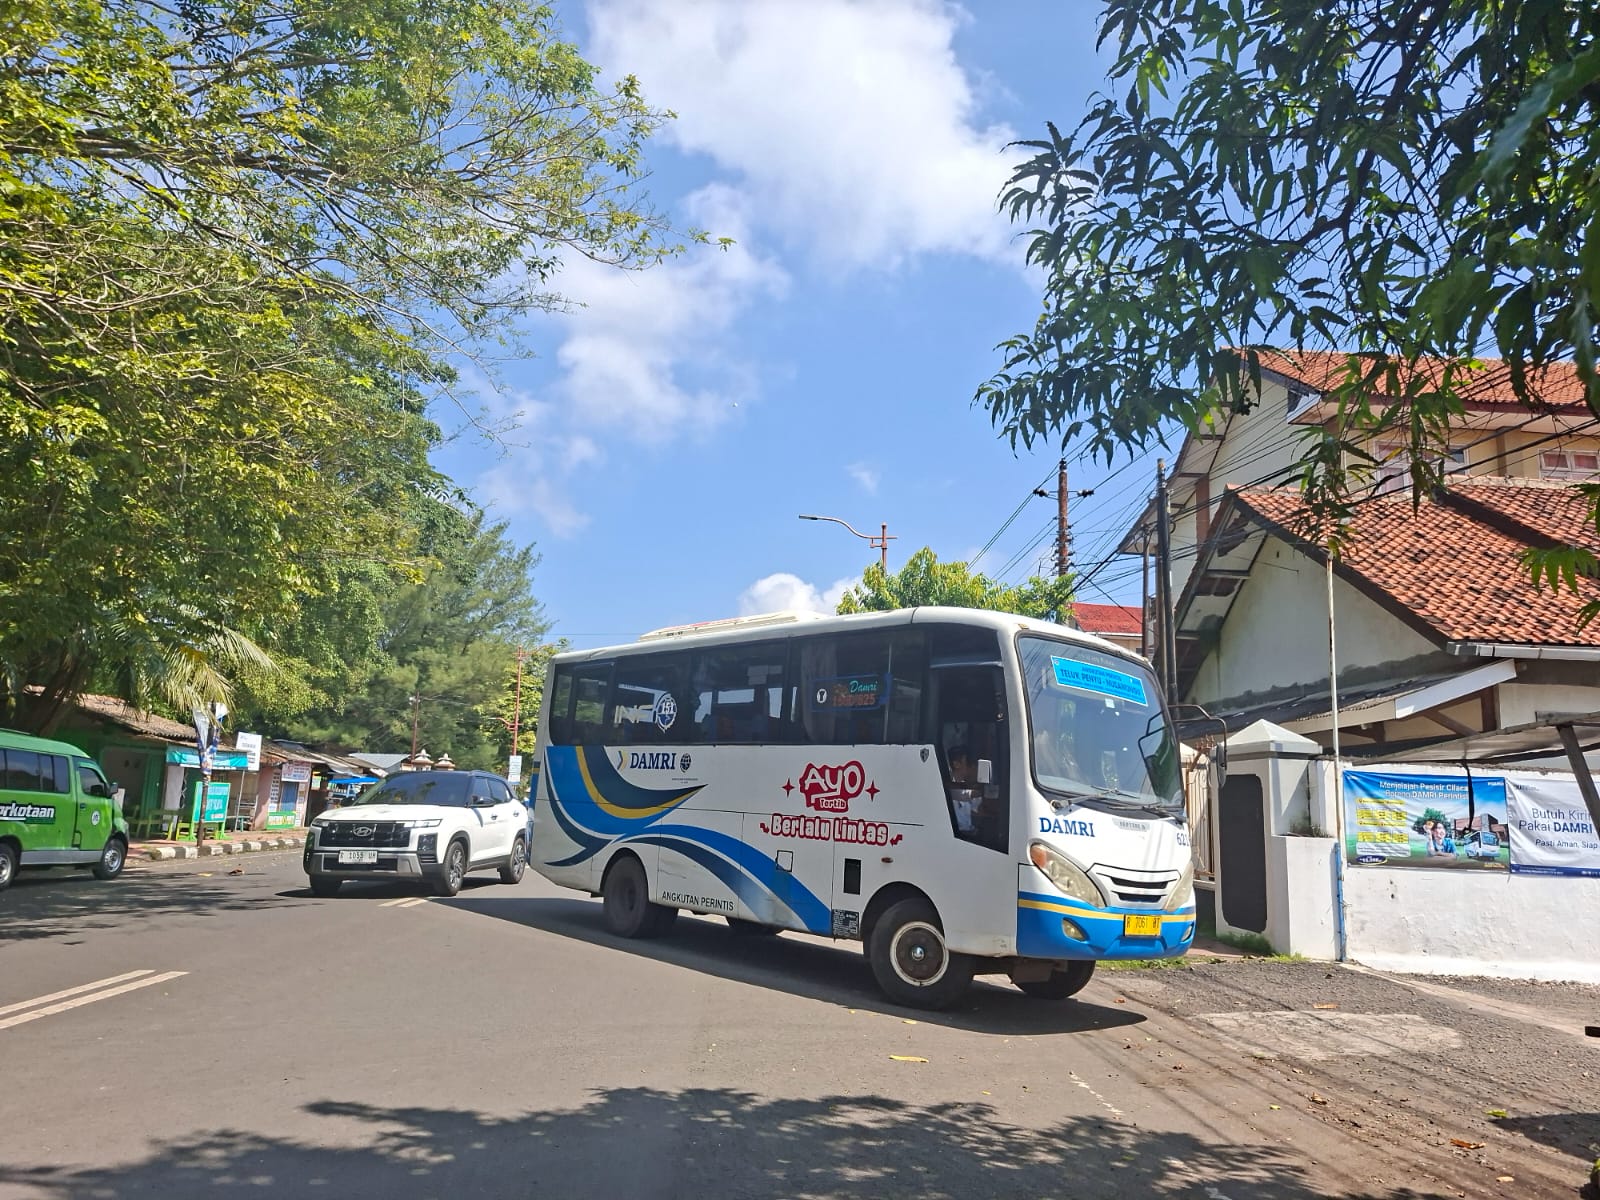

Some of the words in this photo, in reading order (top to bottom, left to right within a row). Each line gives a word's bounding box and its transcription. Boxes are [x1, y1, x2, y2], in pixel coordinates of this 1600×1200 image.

[1060, 669, 1079, 678] TELUK
[630, 752, 677, 770] DAMRI
[803, 764, 862, 802] AYO
[1420, 783, 1445, 791] Pesisir
[819, 799, 847, 810] Tertib
[1532, 808, 1564, 819] Butuh
[771, 814, 832, 840] Berlalu
[834, 818, 889, 843] Lintas
[1039, 817, 1096, 838] DAMRI
[1519, 820, 1550, 831] Pakai
[1554, 822, 1593, 834] DAMRI
[1535, 838, 1555, 847] Pasti
[1582, 841, 1598, 850] Siap
[662, 891, 699, 906] ANGKUTAN
[701, 896, 734, 911] PERINTIS
